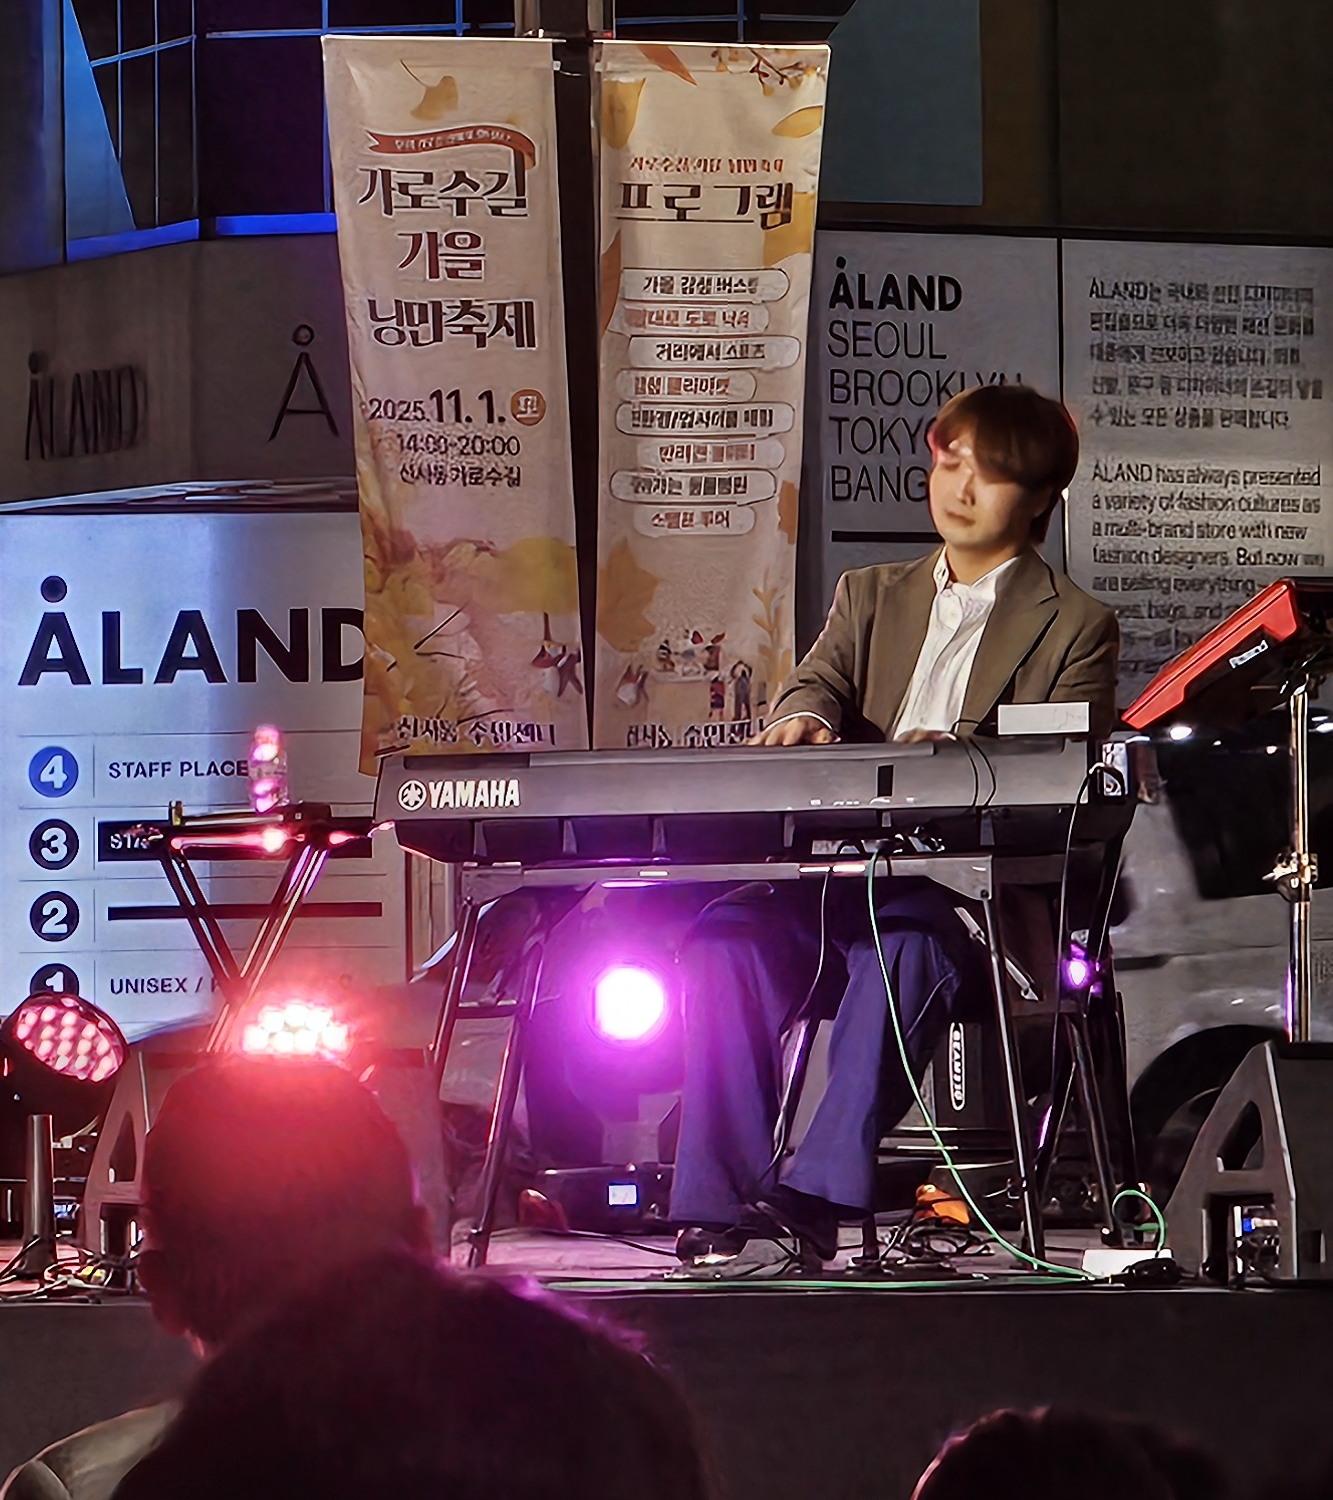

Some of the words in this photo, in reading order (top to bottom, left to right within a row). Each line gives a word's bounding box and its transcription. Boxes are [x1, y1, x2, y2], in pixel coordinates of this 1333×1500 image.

[358, 156, 529, 217] 가로수길
[617, 182, 793, 230] 프로그램
[396, 231, 486, 280] 가을
[367, 298, 537, 350] 낭만축제
[828, 320, 947, 360] SEOUL
[829, 415, 936, 455] TOKY
[1243, 464, 1321, 488] presented
[108, 760, 173, 779] STAFF
[179, 759, 249, 778] PLACE
[428, 779, 521, 810] YAMAHA
[110, 977, 187, 994] UNISEX
